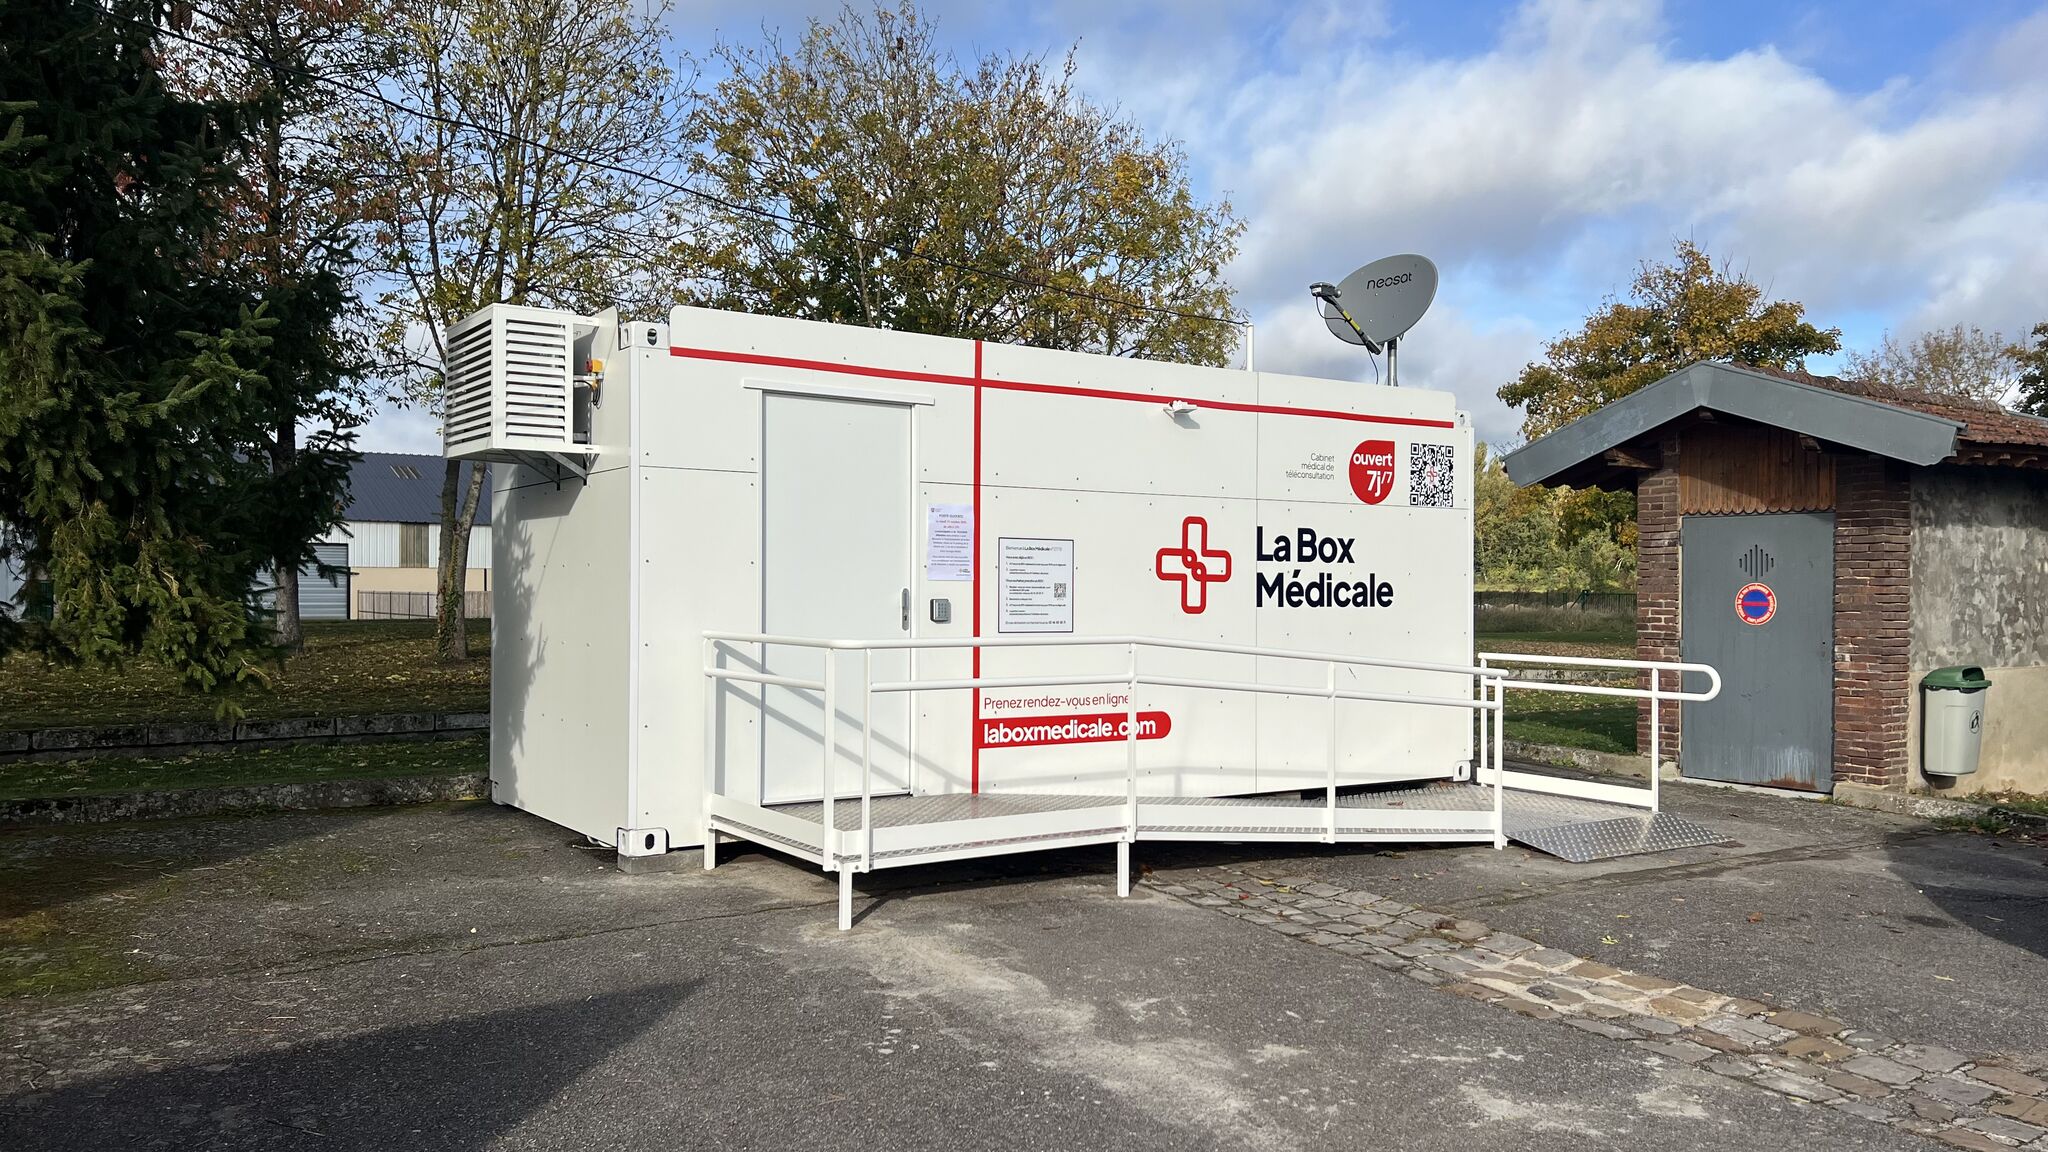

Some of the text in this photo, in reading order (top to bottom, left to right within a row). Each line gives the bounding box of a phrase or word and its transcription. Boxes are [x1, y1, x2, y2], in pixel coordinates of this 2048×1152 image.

[1366, 272, 1412, 290] neosat
[1311, 452, 1335, 462] Cabinet
[1353, 453, 1393, 467] ouvert
[1301, 461, 1335, 471] médical de
[1286, 469, 1335, 481] téléconsultation
[1366, 470, 1393, 497] 7j/7
[1256, 526, 1356, 564] La Box
[1256, 569, 1394, 608] Médicale
[984, 697, 1022, 710] Prenez
[1023, 695, 1091, 709] rendez-vous
[1092, 696, 1106, 706] en
